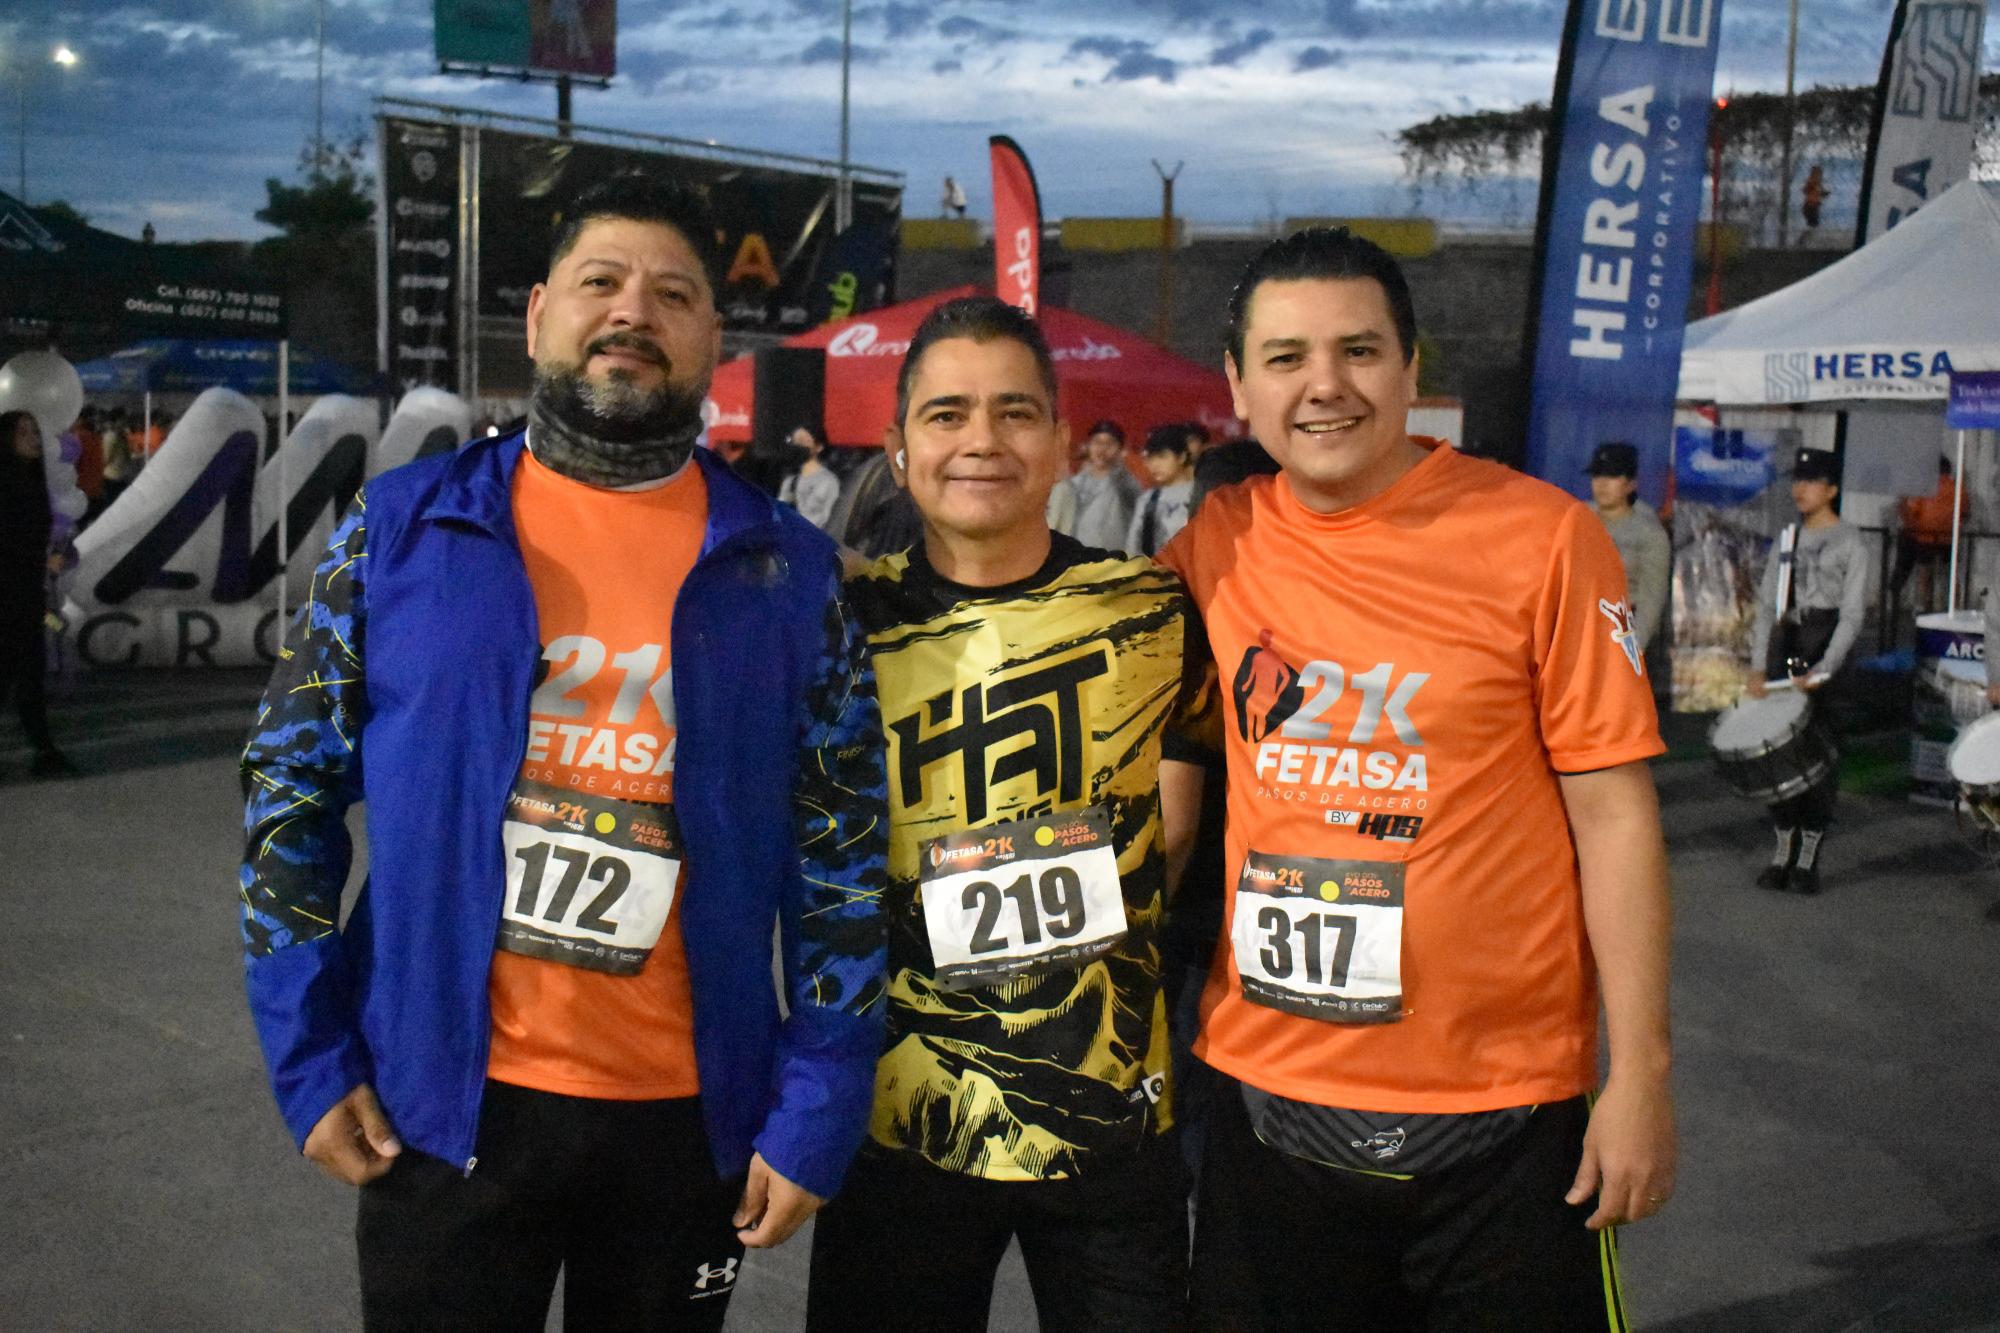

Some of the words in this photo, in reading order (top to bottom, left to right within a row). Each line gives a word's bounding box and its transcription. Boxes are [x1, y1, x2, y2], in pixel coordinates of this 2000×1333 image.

[1569, 84, 1655, 360] HERSA
[1644, 115, 1681, 329] CORPORATIVO
[1814, 351, 1954, 380] HERSA
[1281, 660, 1431, 746] 21K
[1256, 742, 1429, 792] FETASA
[570, 773, 596, 789] DE
[514, 796, 556, 814] FETASA
[556, 801, 589, 825] 21K
[1256, 786, 1308, 802] PASOS
[1320, 792, 1344, 807] DE
[1357, 796, 1427, 811] ACERO
[1331, 811, 1351, 823] BY
[630, 822, 669, 839] PASOS
[633, 834, 673, 849] ACERO
[1054, 824, 1090, 840] PASOS
[1062, 832, 1099, 847] ACERO
[946, 844, 984, 861] FETASA
[983, 836, 1015, 857] 21K
[514, 840, 632, 936] 172
[1249, 867, 1277, 882] FETASA
[1276, 867, 1305, 887] 21K
[1344, 876, 1383, 888] PASOS
[1350, 887, 1391, 899] ACERO
[961, 865, 1087, 956] 219
[1257, 906, 1358, 989] 317
